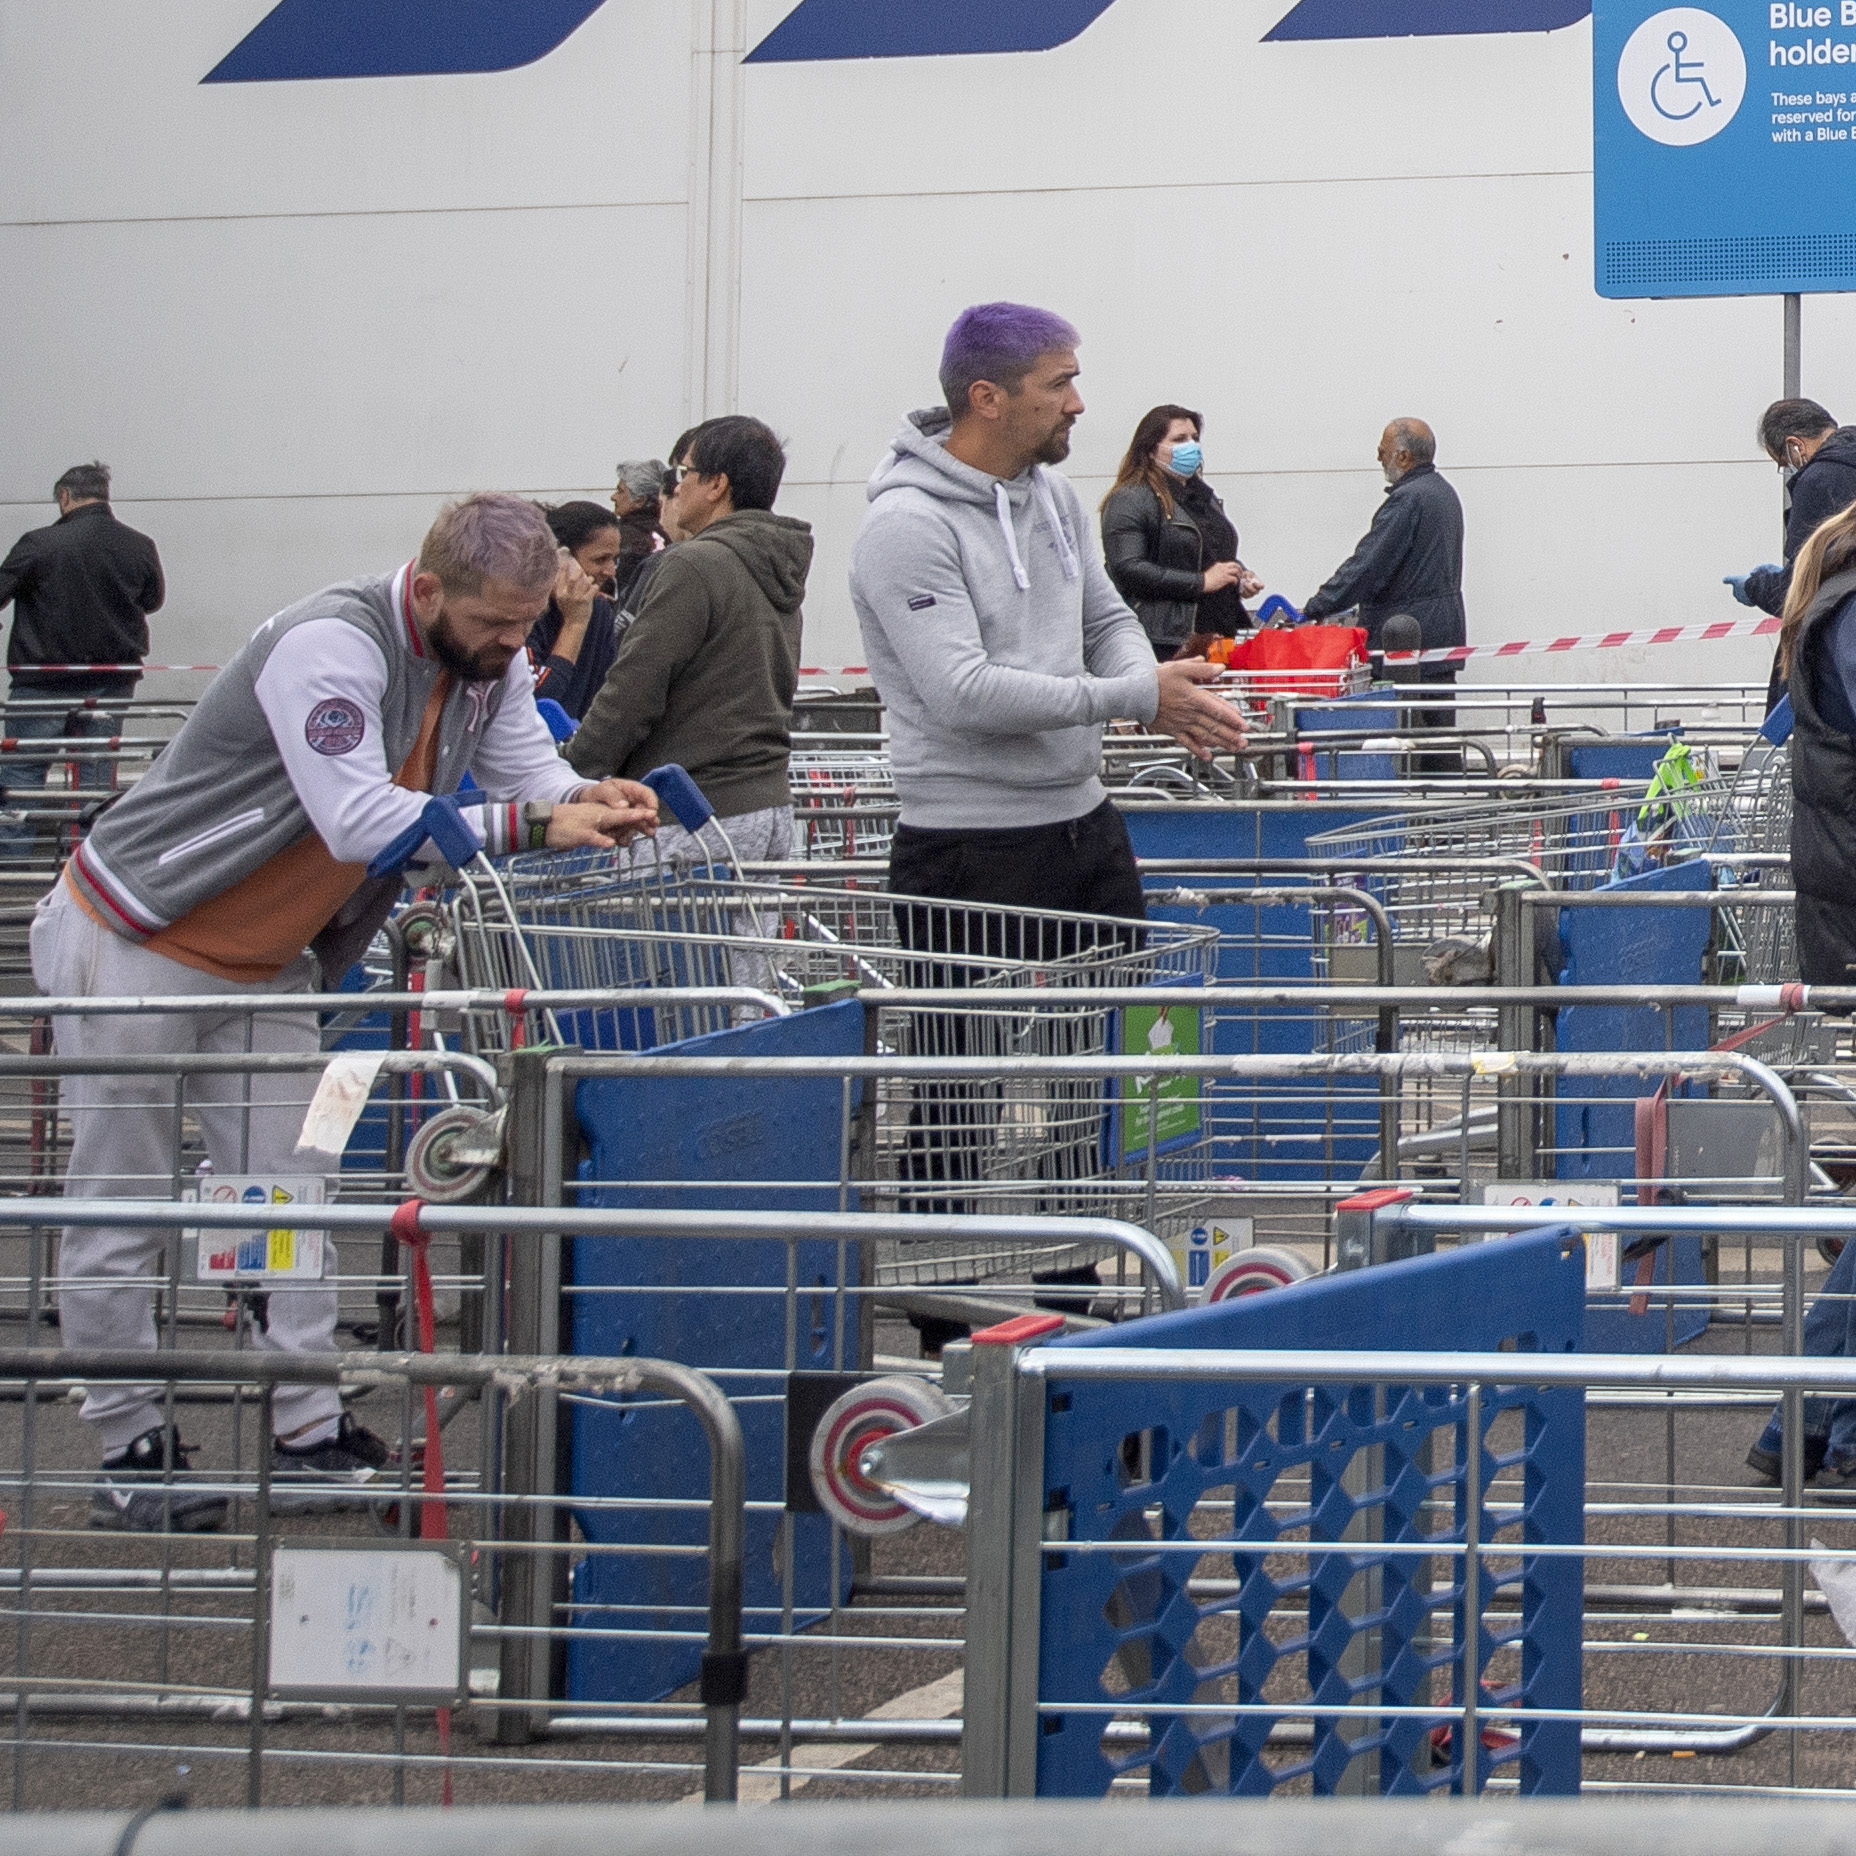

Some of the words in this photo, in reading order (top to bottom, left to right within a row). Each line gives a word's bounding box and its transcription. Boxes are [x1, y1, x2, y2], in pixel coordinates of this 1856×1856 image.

[1769, 1, 1831, 29] Blue
[1771, 92, 1813, 106] These
[1815, 91, 1847, 107] bays
[1771, 109, 1833, 125] reserved
[1771, 127, 1802, 143] with
[1804, 130, 1814, 142] a
[1817, 126, 1848, 142] Blue
